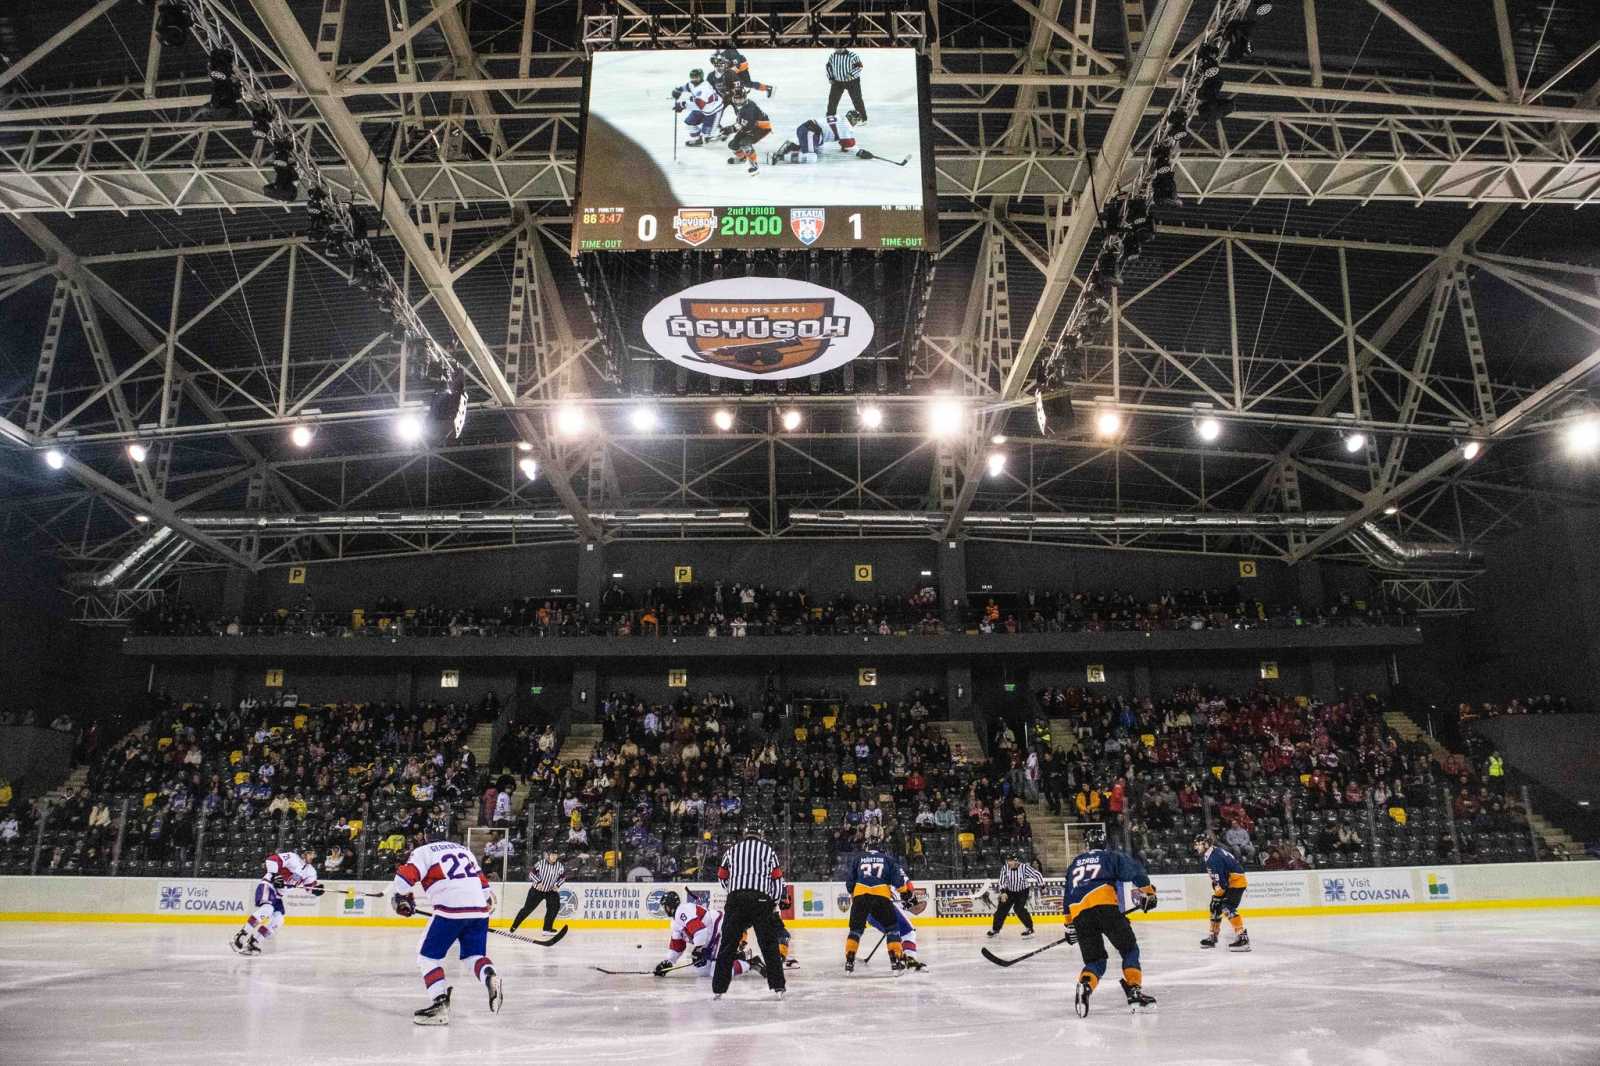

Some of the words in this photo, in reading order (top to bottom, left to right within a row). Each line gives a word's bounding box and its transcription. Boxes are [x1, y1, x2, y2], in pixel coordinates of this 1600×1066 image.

[727, 207, 744, 215] 2nd
[745, 207, 776, 215] PERIOD
[583, 214, 597, 224] 86
[599, 214, 622, 224] 3:47
[638, 214, 658, 241] 0
[720, 215, 783, 235] 20:00
[848, 213, 862, 240] 1
[710, 305, 807, 313] HÁROMSZÉKI
[858, 567, 869, 578] O
[1242, 563, 1253, 574] O
[293, 569, 302, 581] P
[678, 569, 688, 580] P
[673, 672, 683, 684] H
[862, 670, 874, 682] G
[441, 852, 482, 880] 22
[1076, 856, 1100, 866] SZABÓ
[860, 862, 885, 879] 37
[1072, 864, 1102, 888] 27
[1348, 878, 1370, 888] Visit
[187, 887, 209, 897] Visit
[584, 887, 640, 898] SZÉKELYFÖLDI
[1349, 888, 1411, 901] COVASNA
[184, 899, 245, 912] COVASNA
[583, 898, 640, 909] JÉGKORONG
[583, 910, 640, 919] AKADÉMIA
